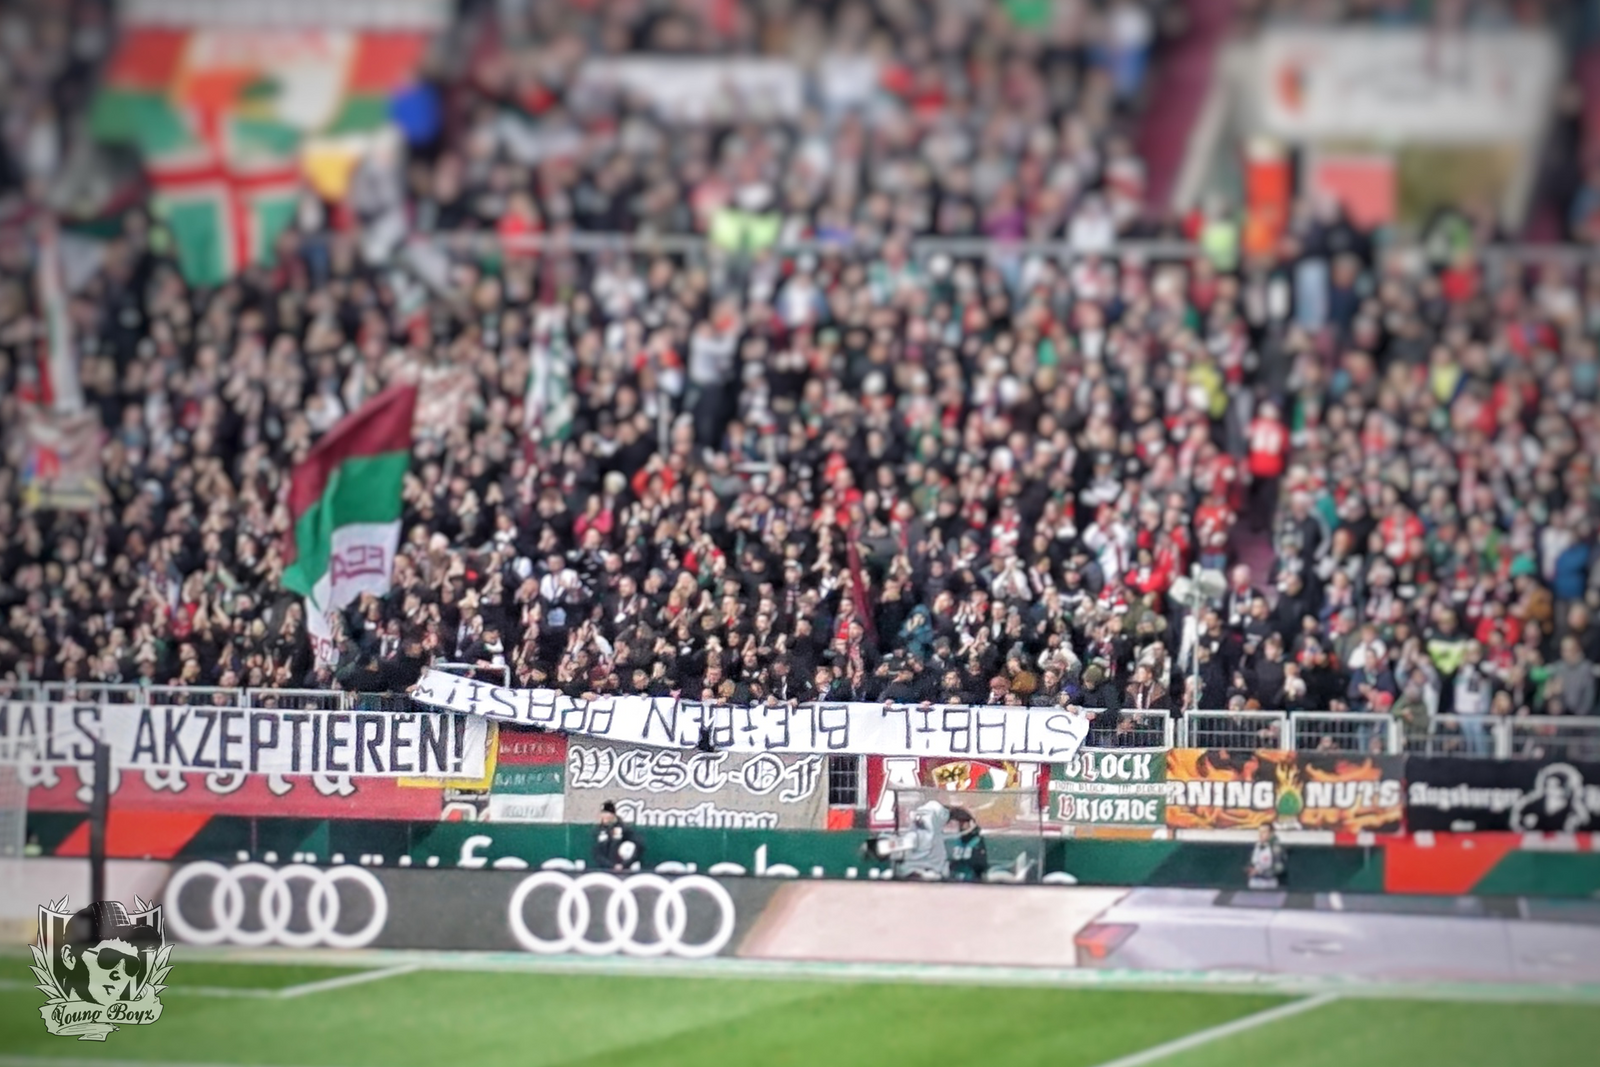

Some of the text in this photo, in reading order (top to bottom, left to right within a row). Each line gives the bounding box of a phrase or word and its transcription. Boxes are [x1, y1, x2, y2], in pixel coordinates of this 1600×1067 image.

[131, 707, 463, 772] AKZEPTIEREN!
[1065, 751, 1153, 781] BLOCK
[1057, 793, 1159, 822] BRIGADE
